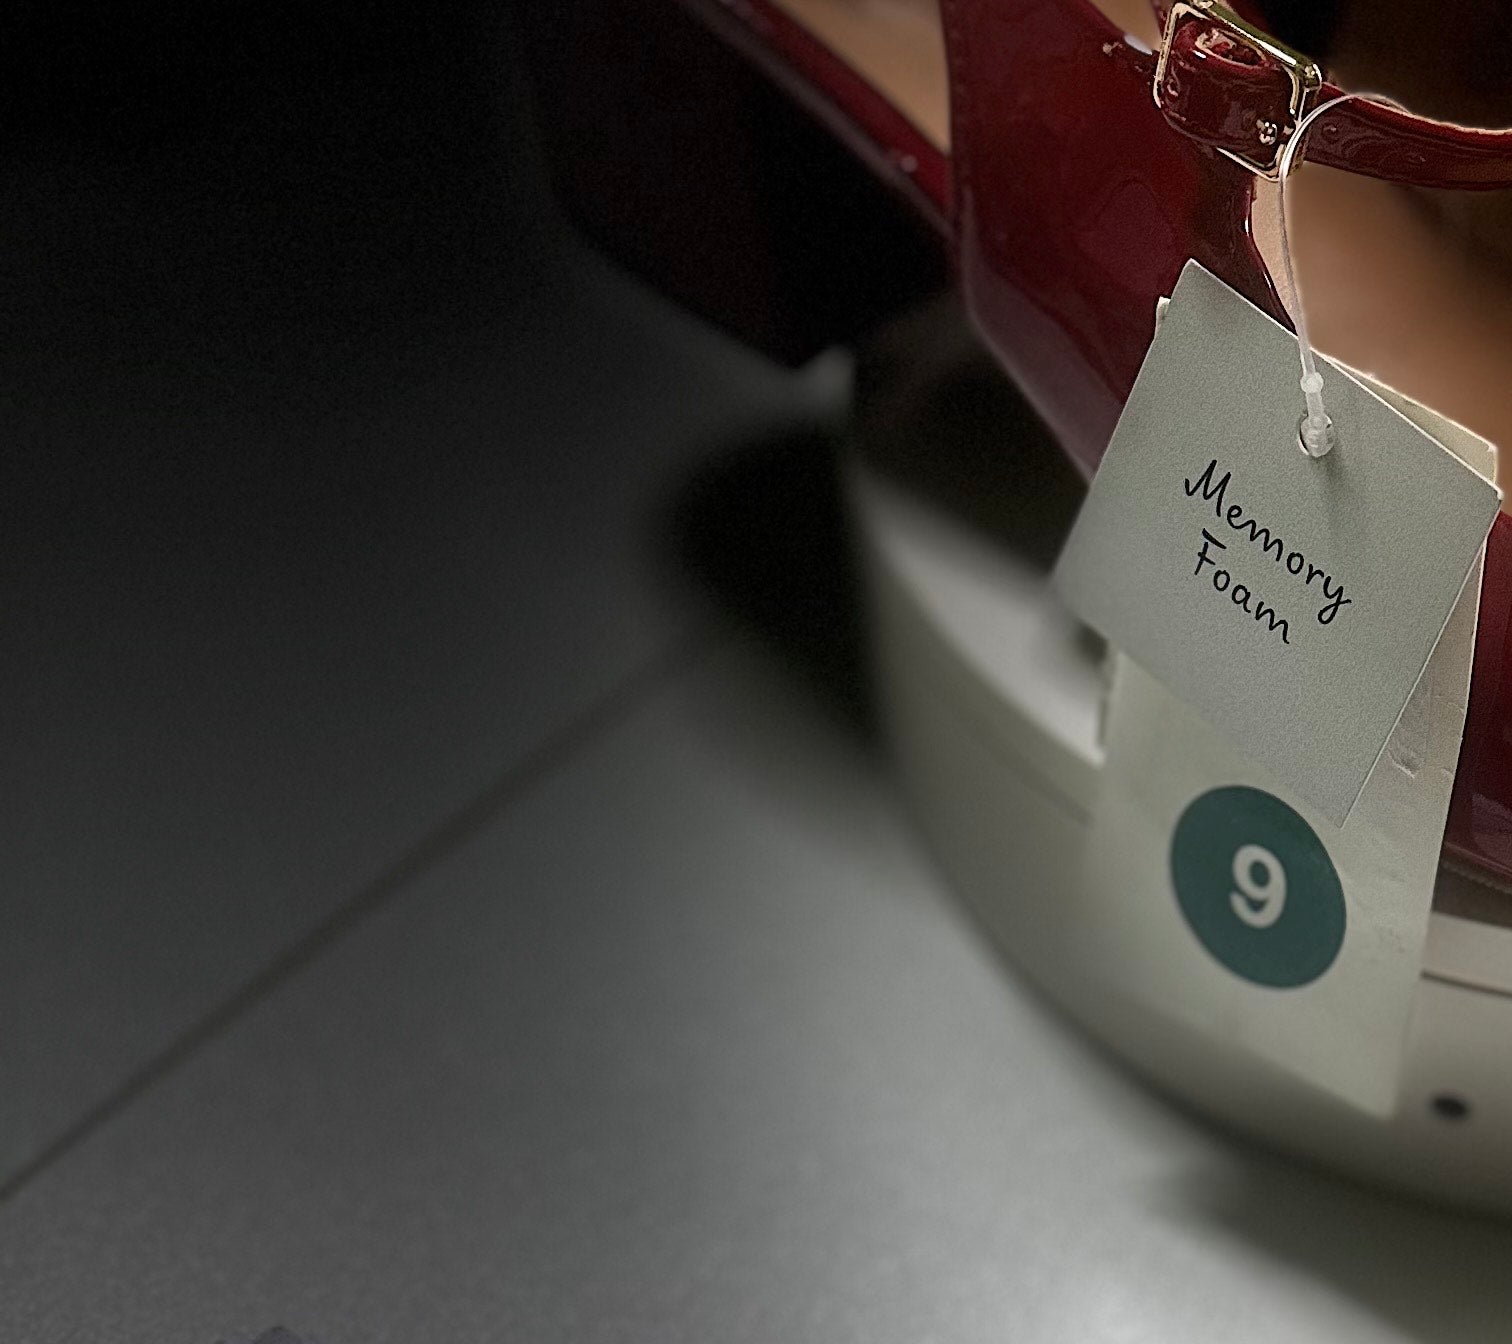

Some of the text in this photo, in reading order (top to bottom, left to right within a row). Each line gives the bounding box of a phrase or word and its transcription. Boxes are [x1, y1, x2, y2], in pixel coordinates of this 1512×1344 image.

[1184, 460, 1351, 624] Memory
[1195, 528, 1290, 644] Foam
[1230, 844, 1287, 928] 9
